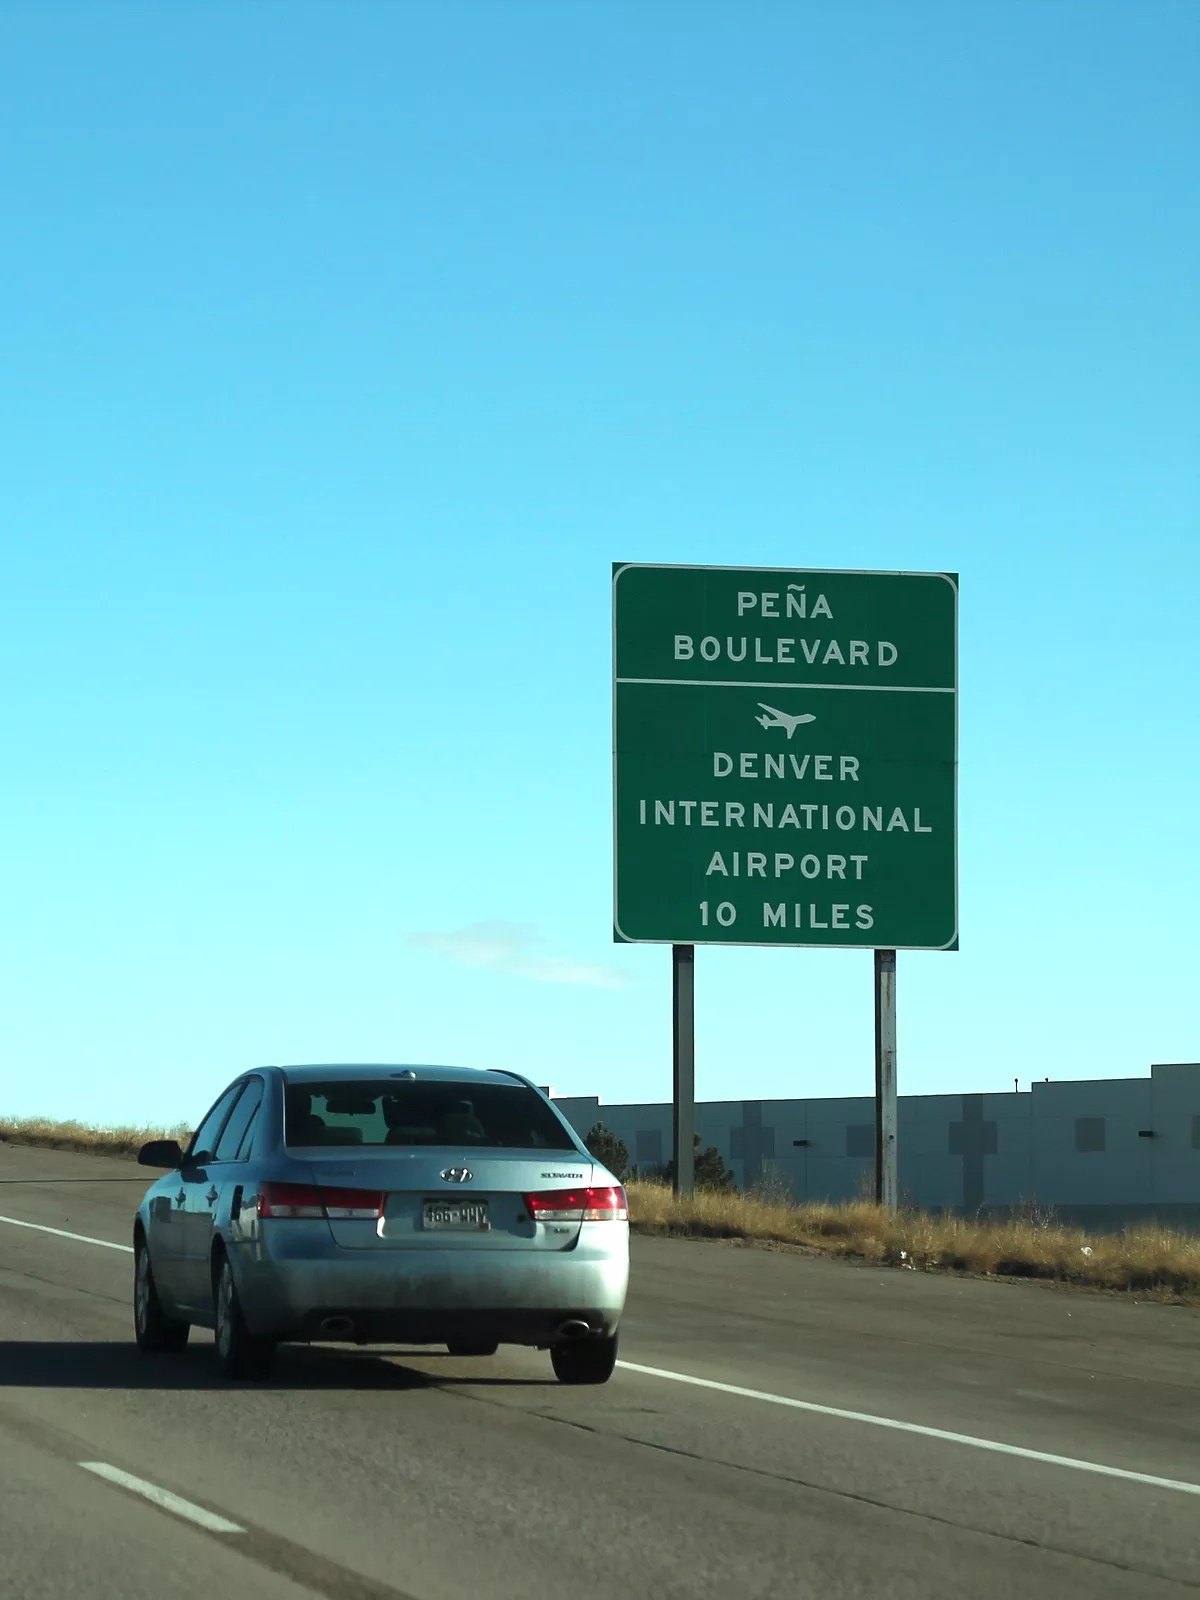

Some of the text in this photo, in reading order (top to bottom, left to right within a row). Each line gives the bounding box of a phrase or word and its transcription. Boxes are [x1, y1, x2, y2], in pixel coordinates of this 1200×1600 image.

[738, 584, 833, 618] PEÑA
[674, 635, 898, 666] BOULEVARD
[713, 752, 860, 781] DENVER
[640, 799, 932, 833] INTERNATIONAL
[706, 851, 868, 880] AIRPORT
[699, 901, 874, 930] 10 MILES
